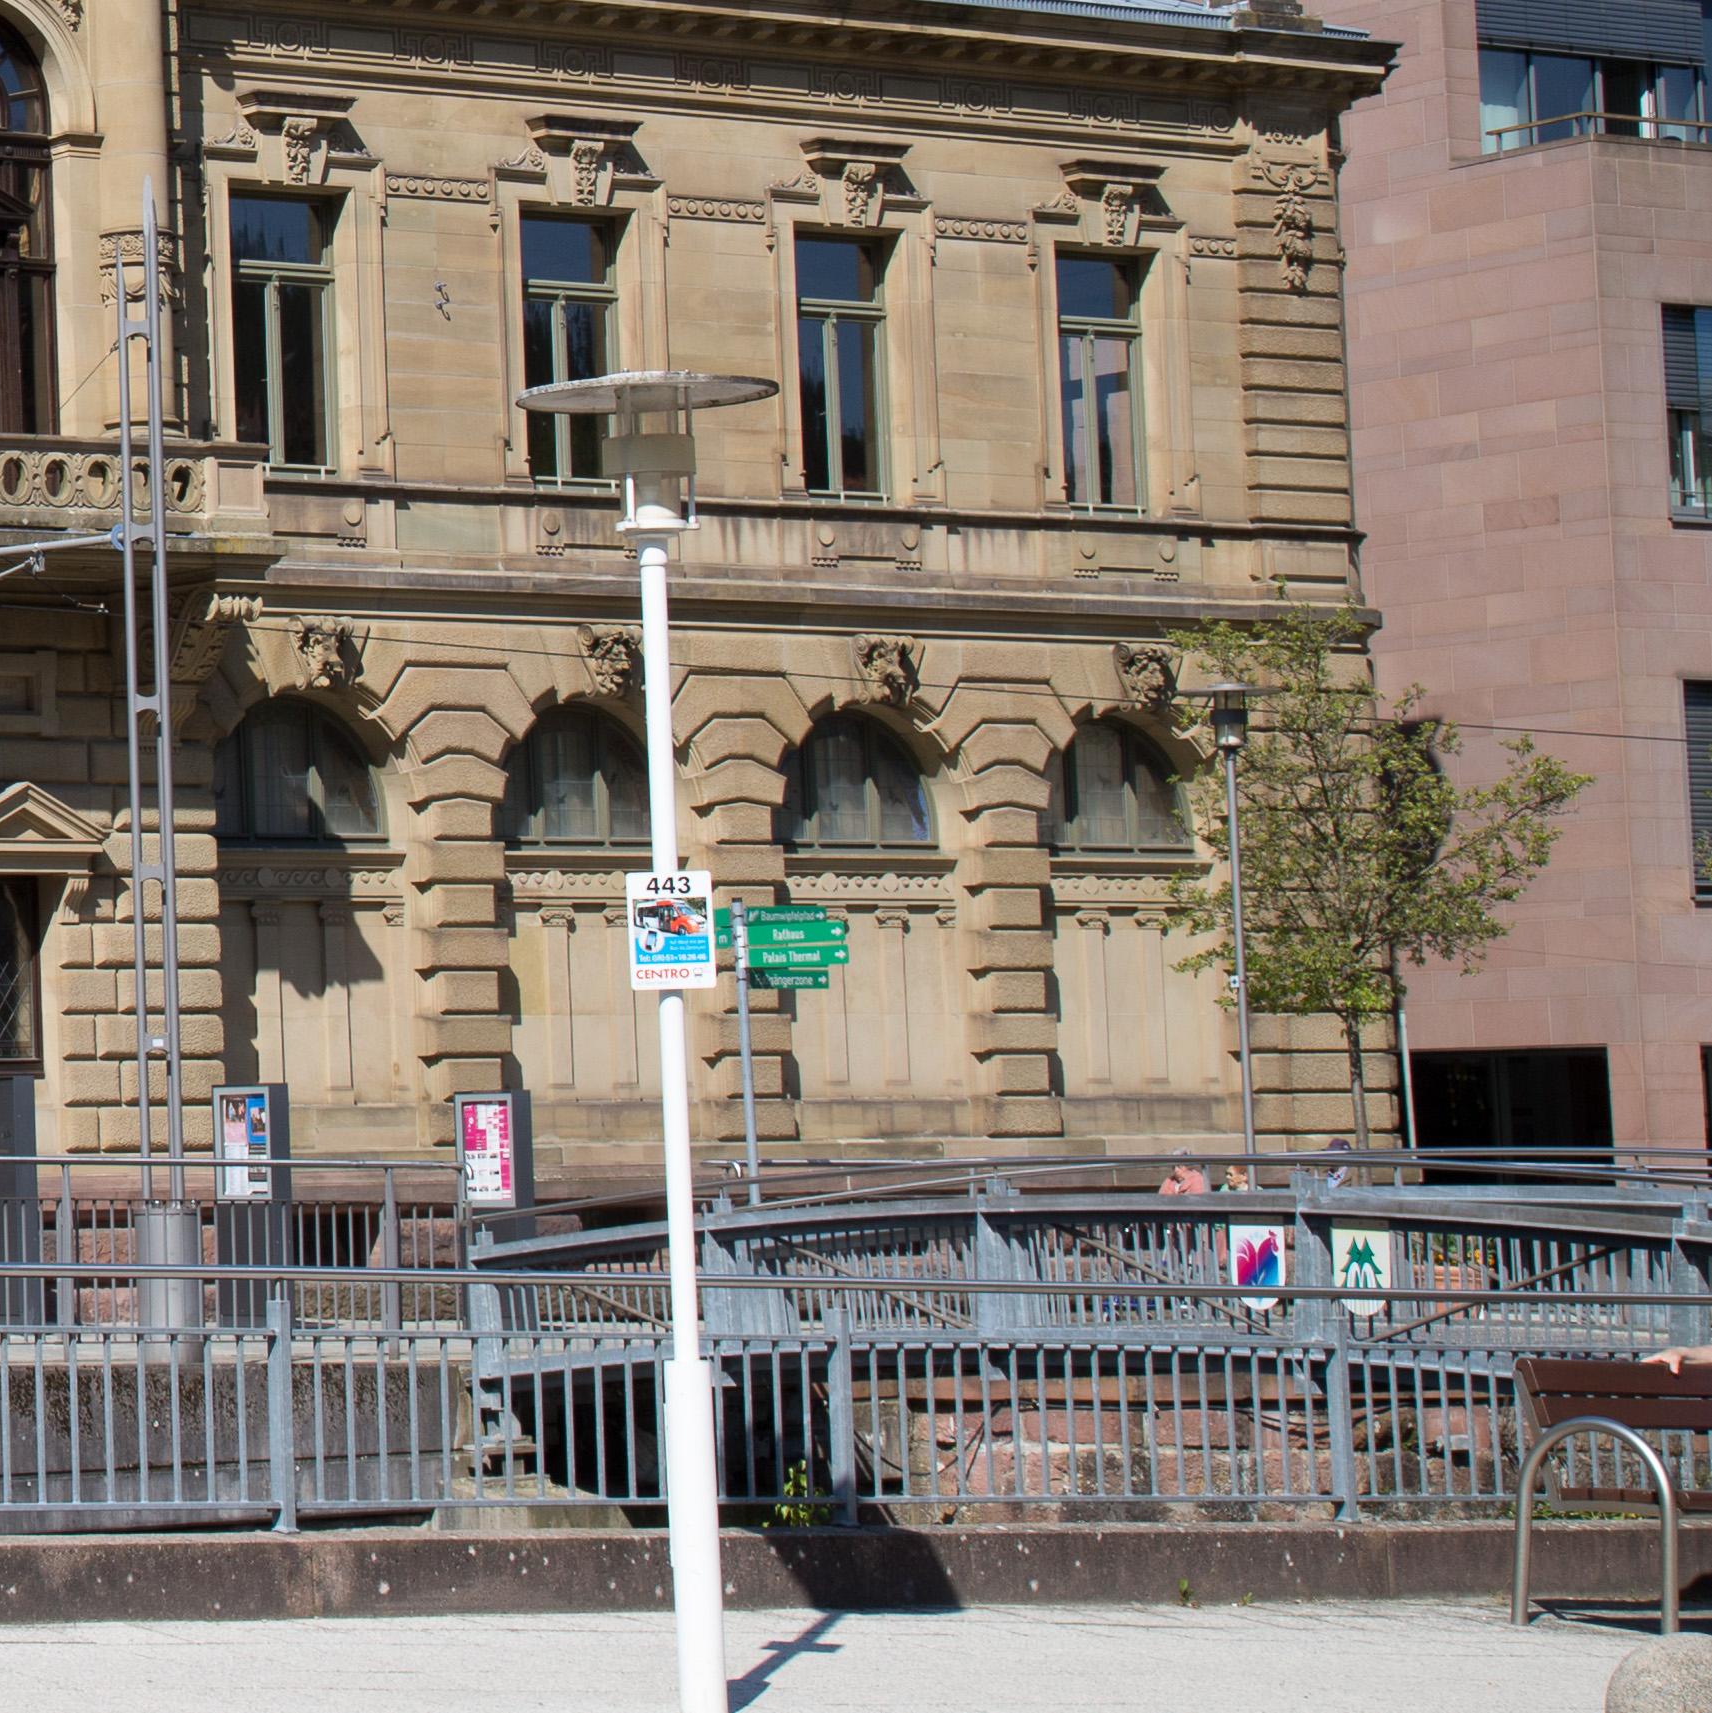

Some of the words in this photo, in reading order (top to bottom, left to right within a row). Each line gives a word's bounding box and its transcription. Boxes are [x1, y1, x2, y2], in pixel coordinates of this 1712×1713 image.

[646, 876, 692, 895] 443
[772, 928, 806, 942] Rathaus
[762, 951, 787, 964] Palais
[788, 950, 821, 963] Thermal
[636, 968, 690, 980] CENTRO
